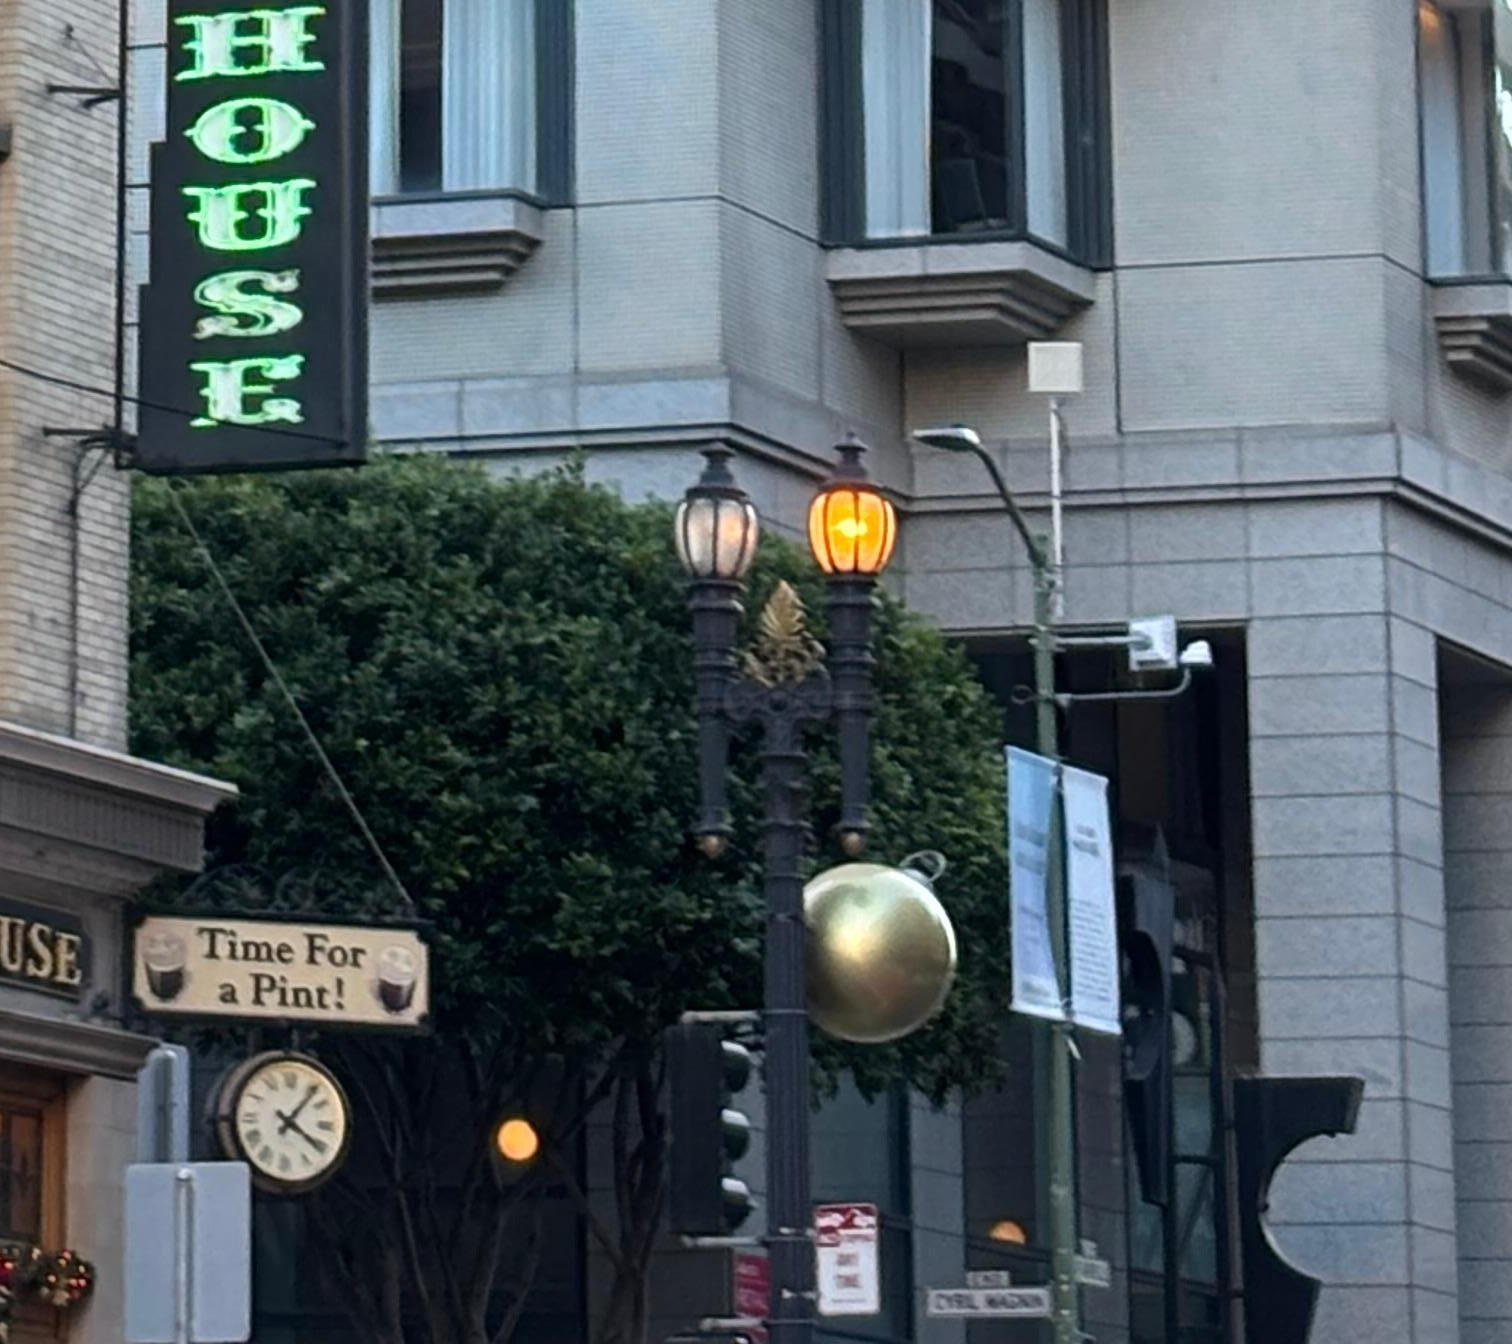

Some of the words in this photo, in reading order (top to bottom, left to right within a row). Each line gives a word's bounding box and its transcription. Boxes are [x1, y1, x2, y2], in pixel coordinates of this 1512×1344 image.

[174, 7, 326, 428] HOUSE
[197, 927, 294, 963] Time
[304, 932, 366, 969] For
[219, 982, 237, 1004] a
[249, 973, 345, 1010] Pint!
